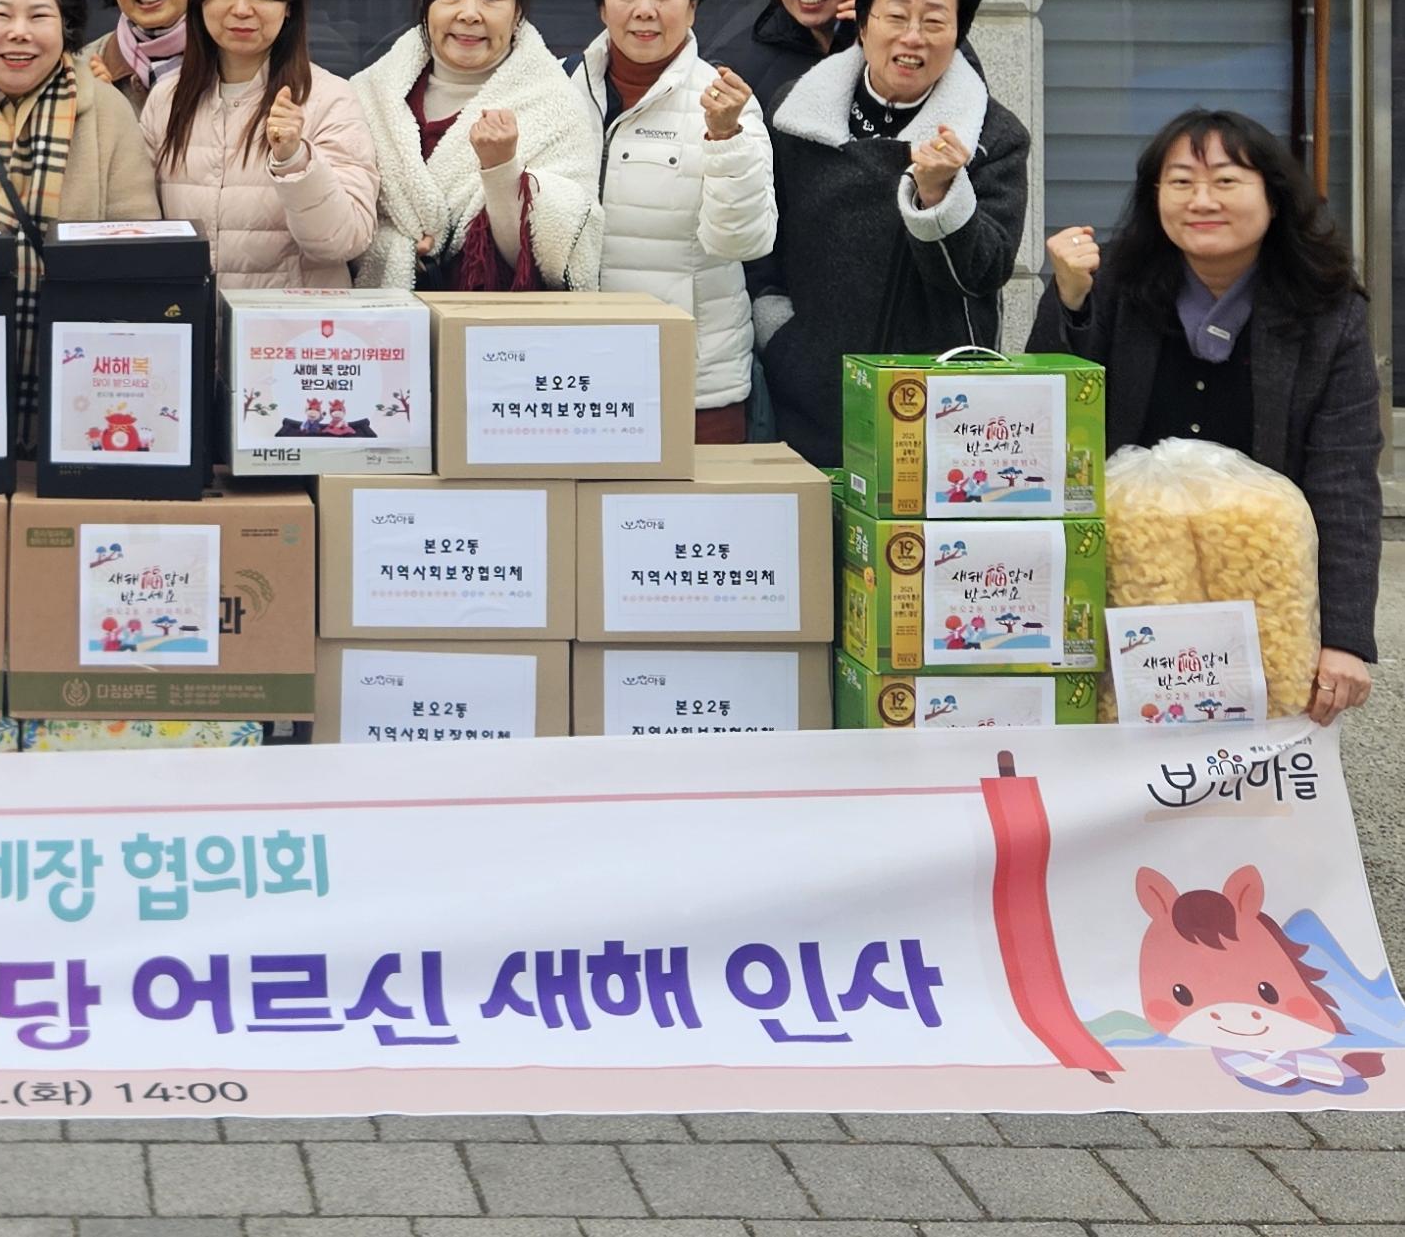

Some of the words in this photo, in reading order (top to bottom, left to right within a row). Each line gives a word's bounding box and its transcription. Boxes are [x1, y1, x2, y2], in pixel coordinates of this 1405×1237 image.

[250, 347, 296, 360] 본오2동
[301, 348, 405, 361] 바르게살기위원회
[322, 364, 333, 376] 복
[337, 364, 361, 376] 많이
[301, 379, 353, 391] 받으세요!
[535, 375, 591, 392] 본오2동
[492, 402, 635, 418] 지역사회보장협의체
[966, 440, 1023, 456] 받으세요
[424, 539, 480, 555] 본오2동
[674, 543, 730, 560] 본오2동
[381, 565, 523, 582] 지역사회보장협의체
[631, 569, 776, 586] 지역사회보장협의체
[964, 586, 1021, 603] 받으세요
[1158, 672, 1220, 690] 받으세요
[412, 701, 468, 718] 본오2동
[675, 700, 731, 716] 본오2동
[121, 829, 330, 921] 협의회
[132, 950, 460, 1046] 어르신
[480, 940, 702, 1030] 새해
[726, 938, 944, 1043] 인사
[115, 1081, 248, 1104] 14:00
